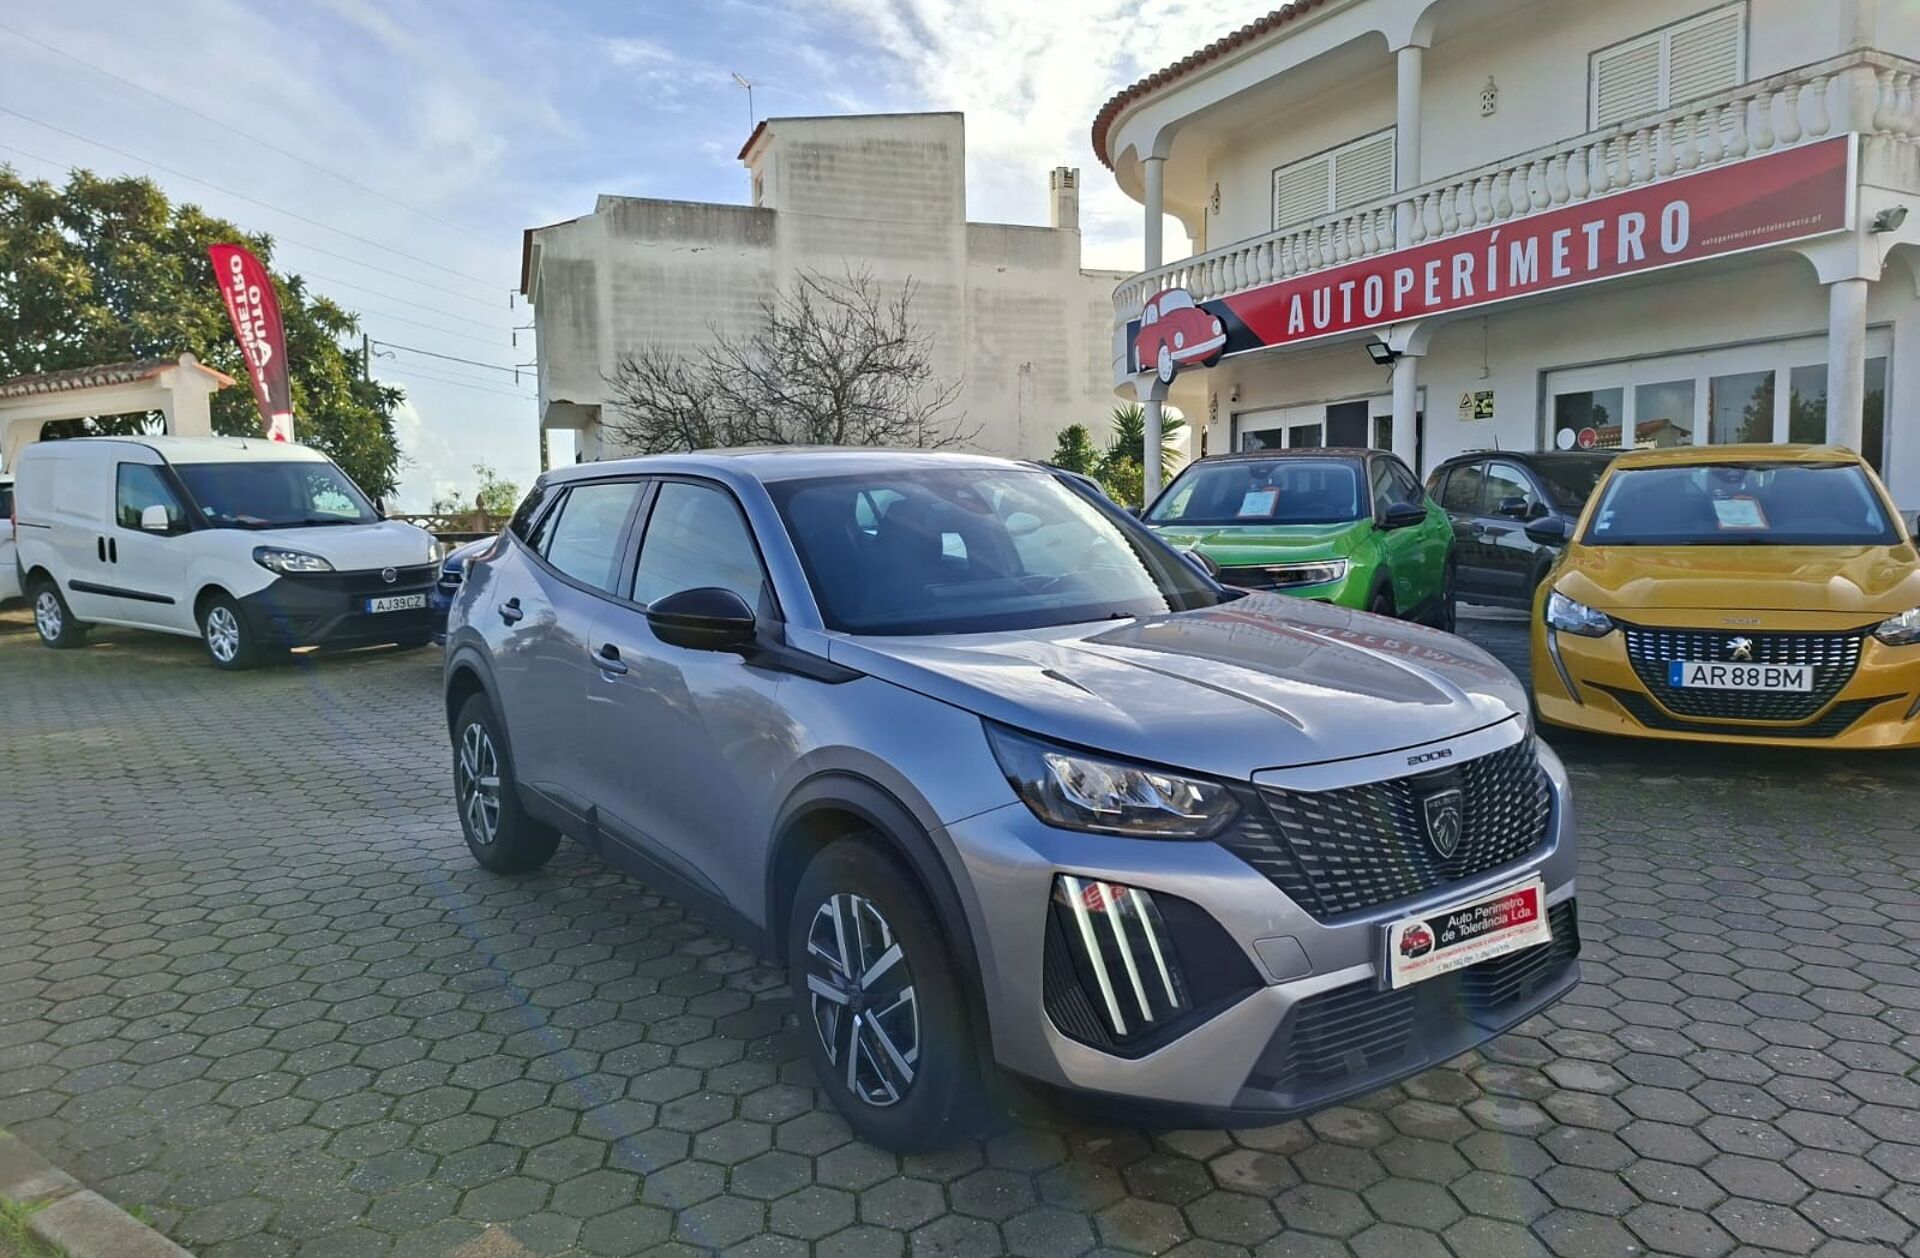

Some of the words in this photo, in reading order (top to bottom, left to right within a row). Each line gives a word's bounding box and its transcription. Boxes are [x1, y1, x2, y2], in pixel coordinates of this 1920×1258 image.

[1288, 200, 1690, 335] AUTOPERÍMETRO
[1407, 748, 1452, 766] 2008
[1447, 912, 1473, 929] Auto
[1441, 929, 1455, 942] de
